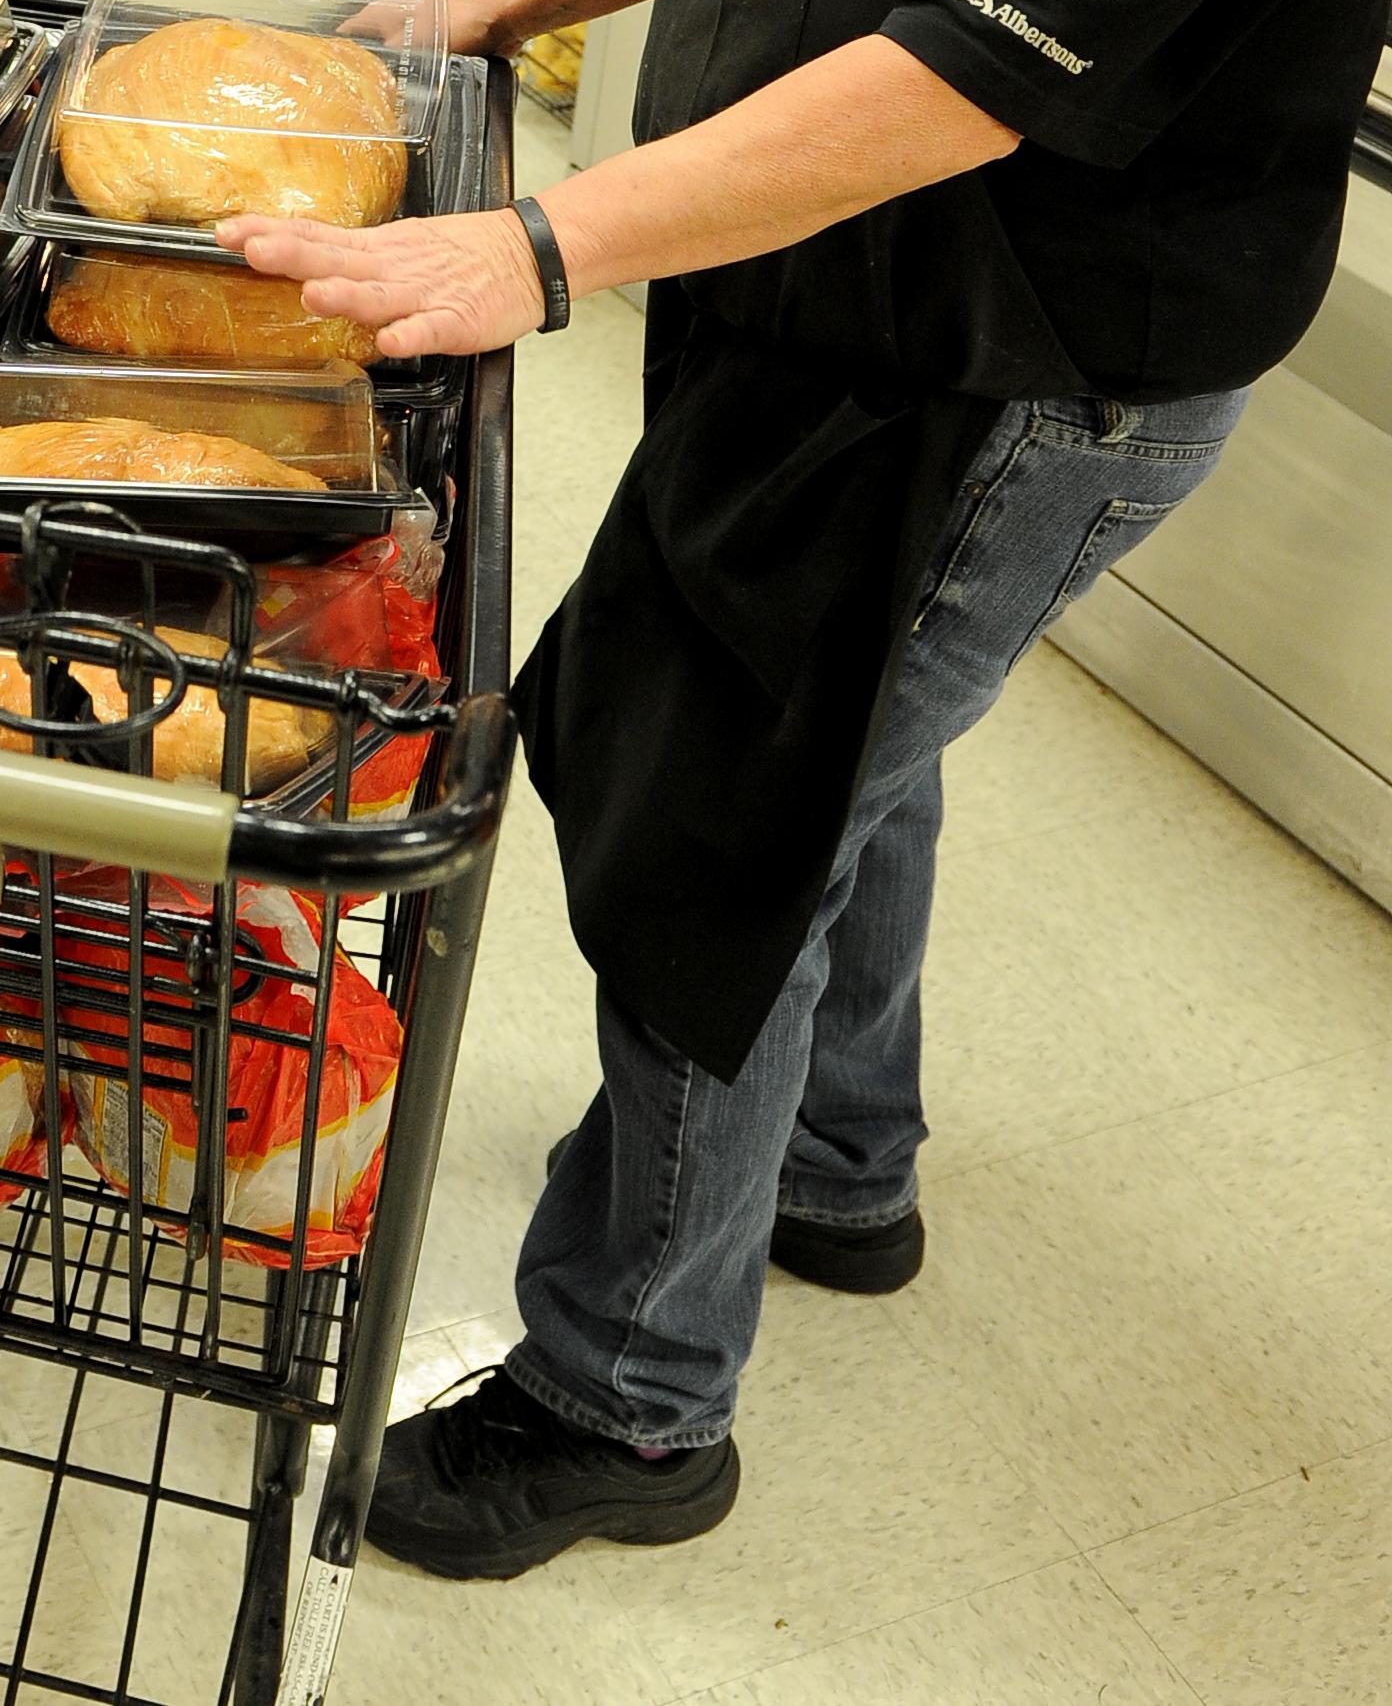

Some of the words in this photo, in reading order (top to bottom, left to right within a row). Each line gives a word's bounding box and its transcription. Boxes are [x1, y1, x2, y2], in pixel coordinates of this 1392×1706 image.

[315, 1566, 328, 1595] CALL
[294, 1597, 309, 1638] REPORT
[308, 1597, 321, 1623] TOLL
[322, 1592, 334, 1620] CART
[302, 1624, 314, 1651] FREE
[319, 1622, 327, 1633] IS
[309, 1634, 324, 1673] FOUND
